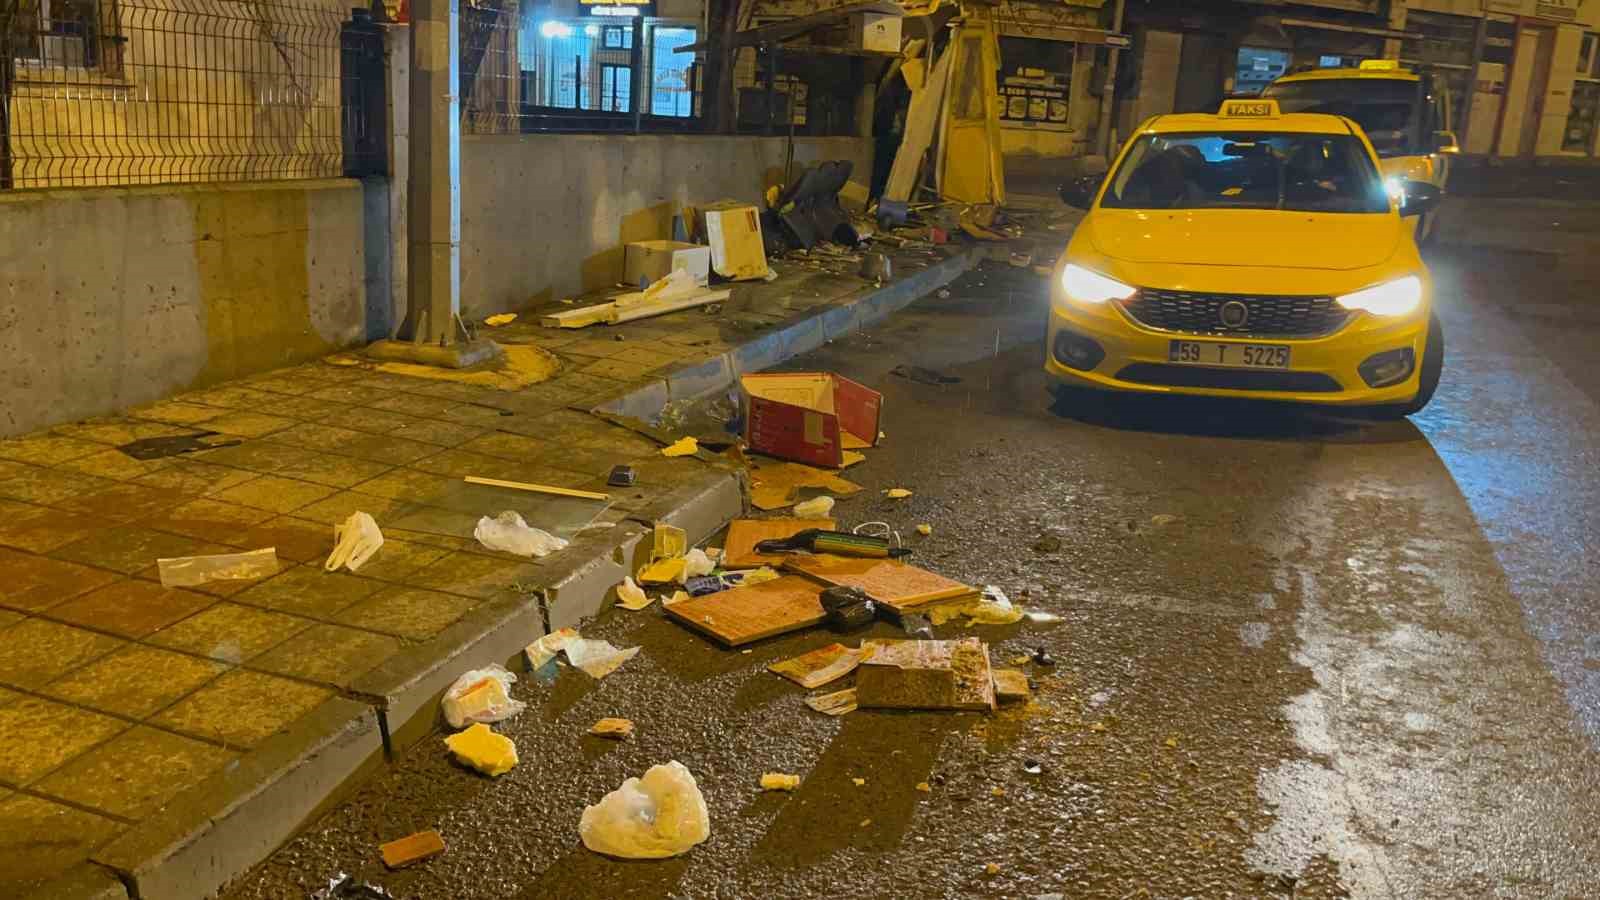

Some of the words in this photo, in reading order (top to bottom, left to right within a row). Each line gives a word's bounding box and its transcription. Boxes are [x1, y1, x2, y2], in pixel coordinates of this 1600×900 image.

[1181, 343, 1200, 361] 59
[1217, 345, 1227, 363] T
[1243, 346, 1289, 366] 5225
